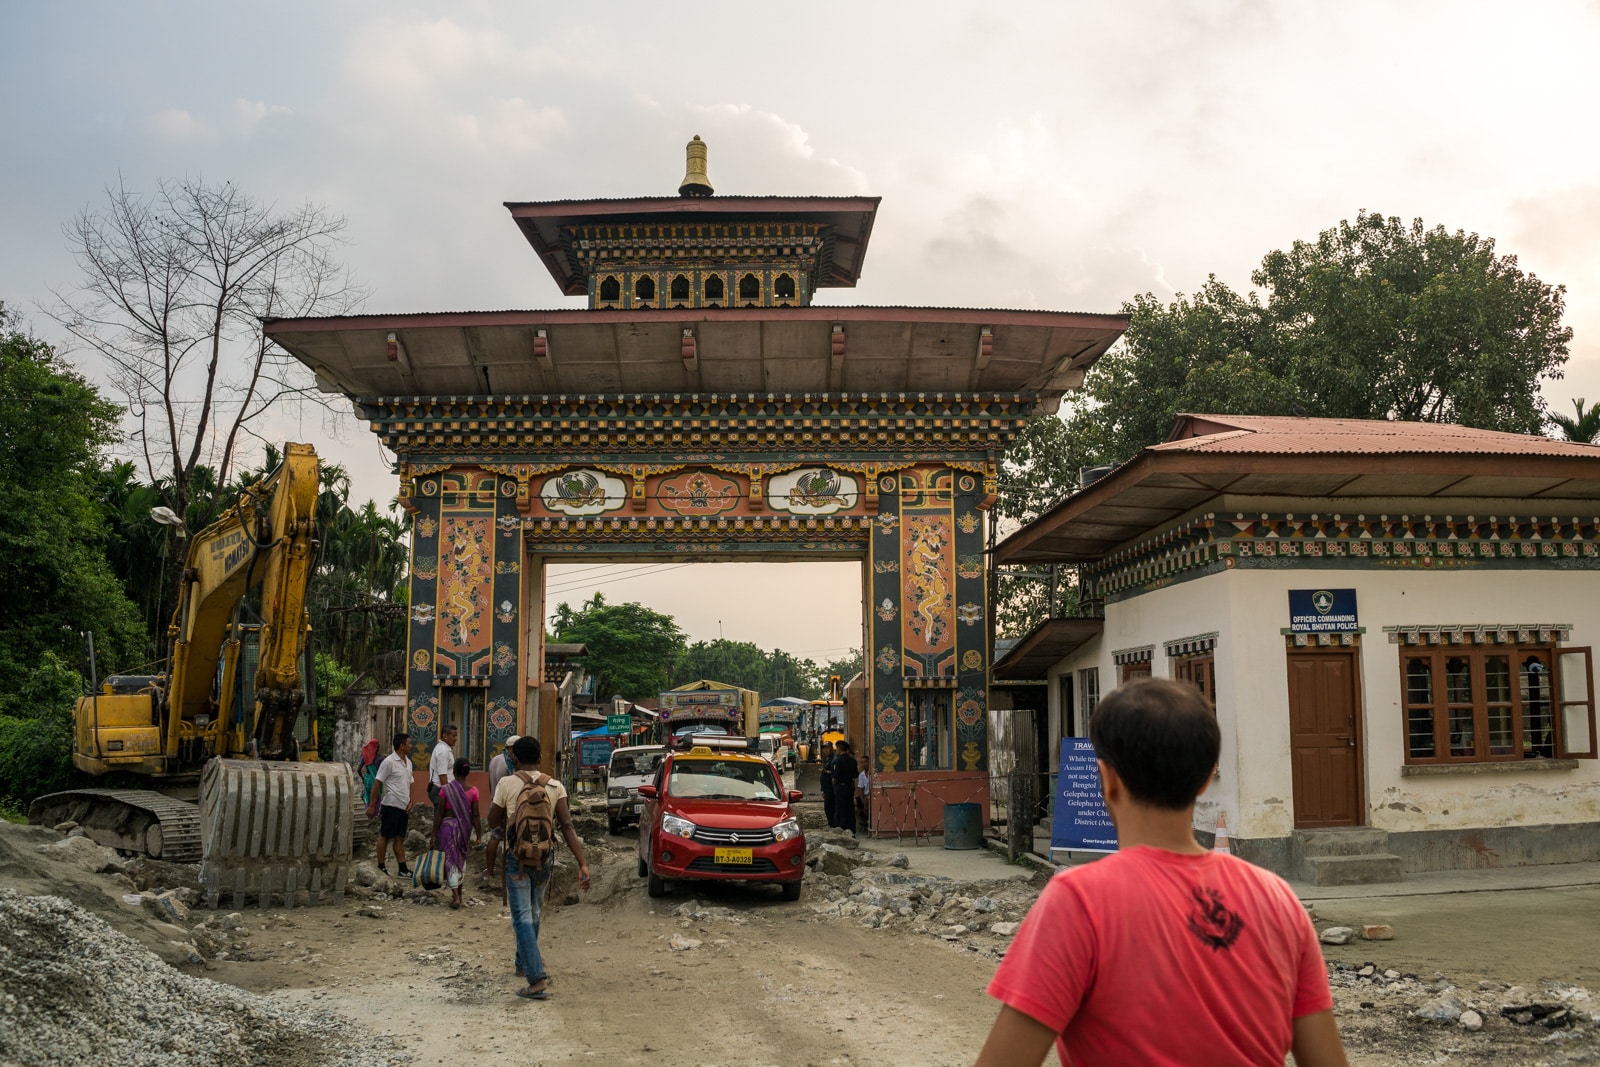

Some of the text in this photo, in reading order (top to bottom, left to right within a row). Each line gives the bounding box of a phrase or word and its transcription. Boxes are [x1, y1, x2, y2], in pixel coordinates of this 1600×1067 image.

[224, 537, 250, 574] KOMATSU
[1293, 615, 1317, 623] OFFICER
[1312, 622, 1336, 630] BHUTAN
[1074, 742, 1095, 750] TRAV
[1085, 764, 1099, 772] Hig
[1072, 781, 1097, 789] Bengtol
[1063, 790, 1089, 798] Gelephu
[1067, 799, 1094, 807] Gelephu
[1074, 818, 1098, 826] District
[715, 855, 752, 864] BT-3-A0328
